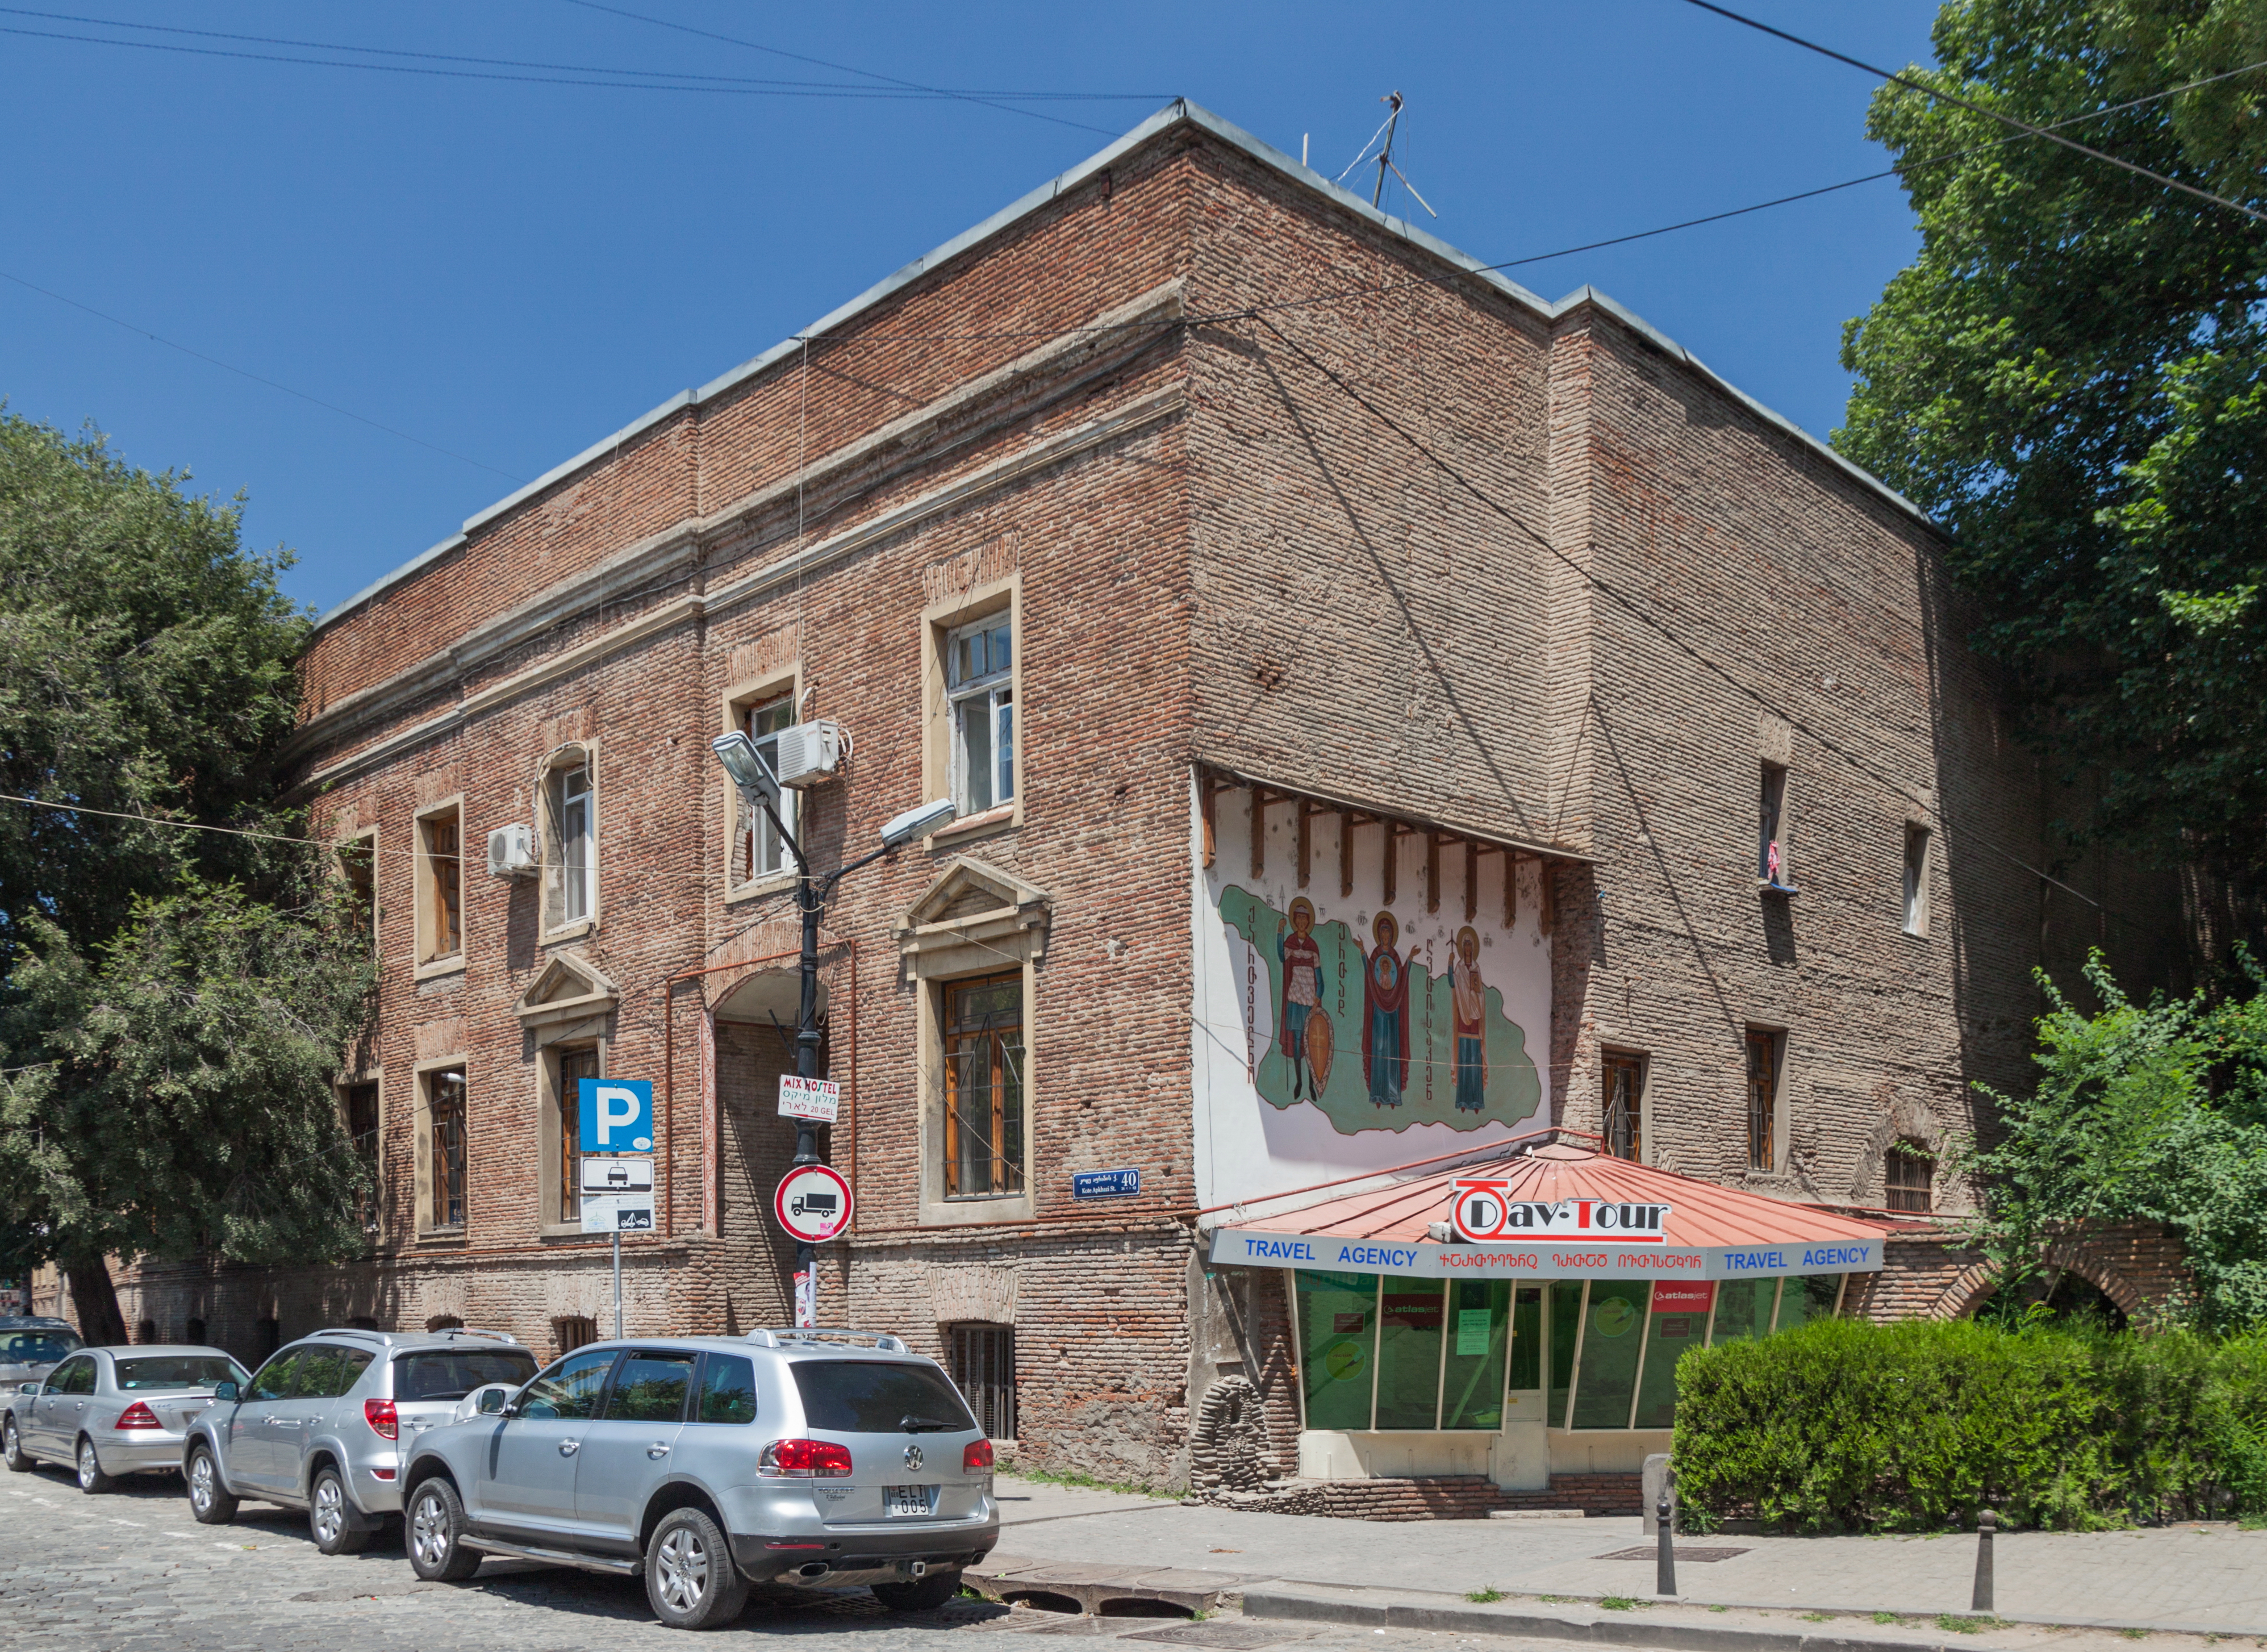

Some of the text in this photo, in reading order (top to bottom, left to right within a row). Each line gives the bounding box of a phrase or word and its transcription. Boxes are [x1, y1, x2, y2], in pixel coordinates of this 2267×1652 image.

[784, 1077, 836, 1095] MIX HOSTEL
[783, 1090, 836, 1104] מלון מיקס
[783, 1101, 807, 1111] לארי
[820, 1107, 834, 1116] GEL
[596, 1087, 641, 1145] P
[1121, 1172, 1137, 1187] 40
[1092, 1186, 1109, 1194] Apkhazi
[1245, 1239, 1418, 1267] TRAVEL AGENCY
[1724, 1247, 1870, 1270] TRAVEL AGENCY
[1665, 1291, 1707, 1300] atlasjet
[1395, 1305, 1439, 1315] atlasjet
[901, 1499, 926, 1513] 005
